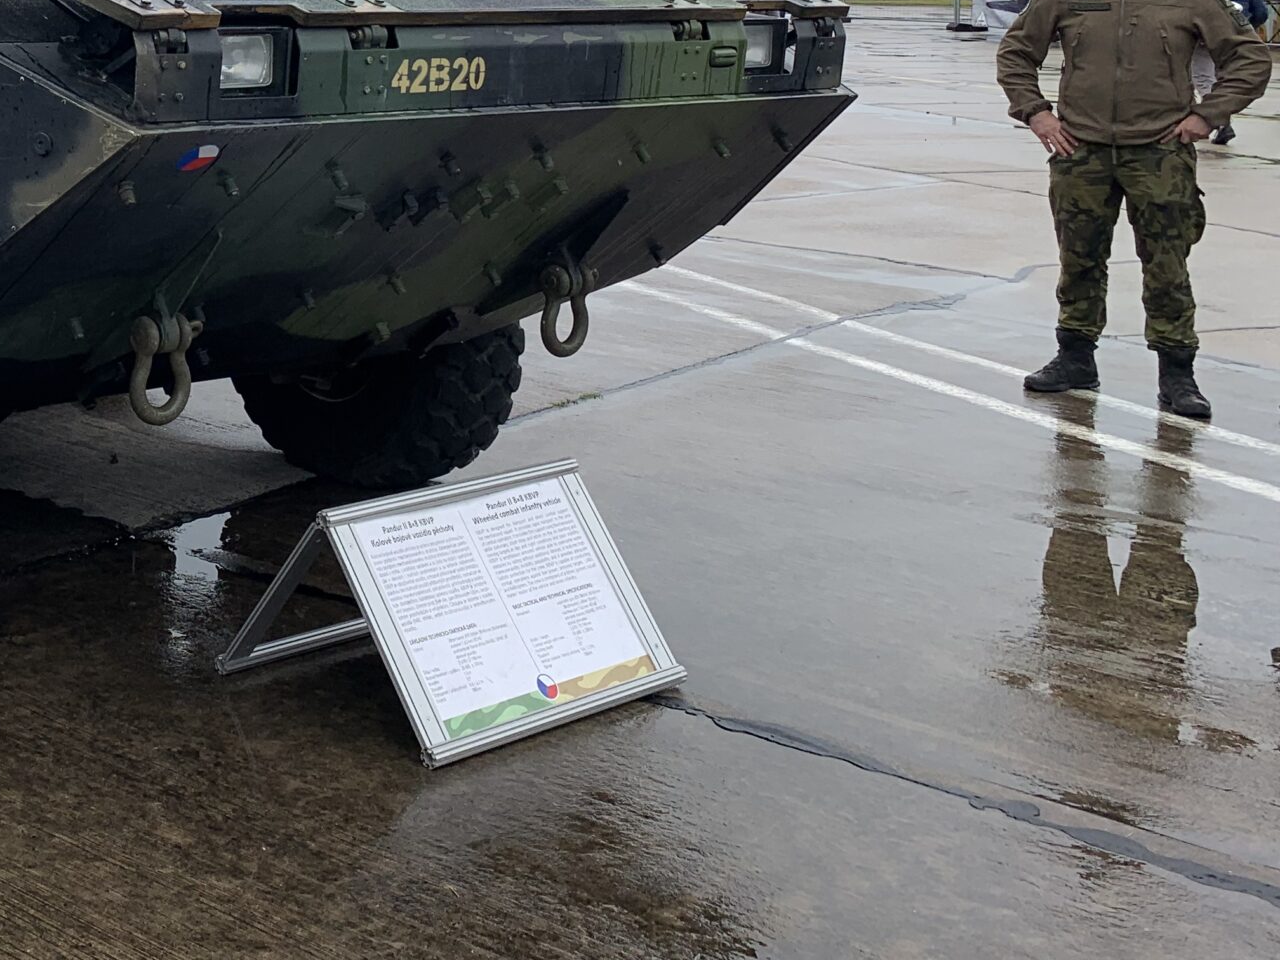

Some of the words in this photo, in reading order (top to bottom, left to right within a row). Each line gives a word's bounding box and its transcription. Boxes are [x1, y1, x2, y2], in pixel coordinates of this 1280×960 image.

[391, 56, 486, 94] 42B20
[485, 500, 507, 510] Pandur
[472, 512, 498, 525] Wheeled
[499, 508, 520, 518] combat
[520, 502, 543, 513] infantry
[543, 497, 561, 507] vehicle
[381, 524, 402, 534] Pandur
[412, 529, 432, 539] vozidlo
